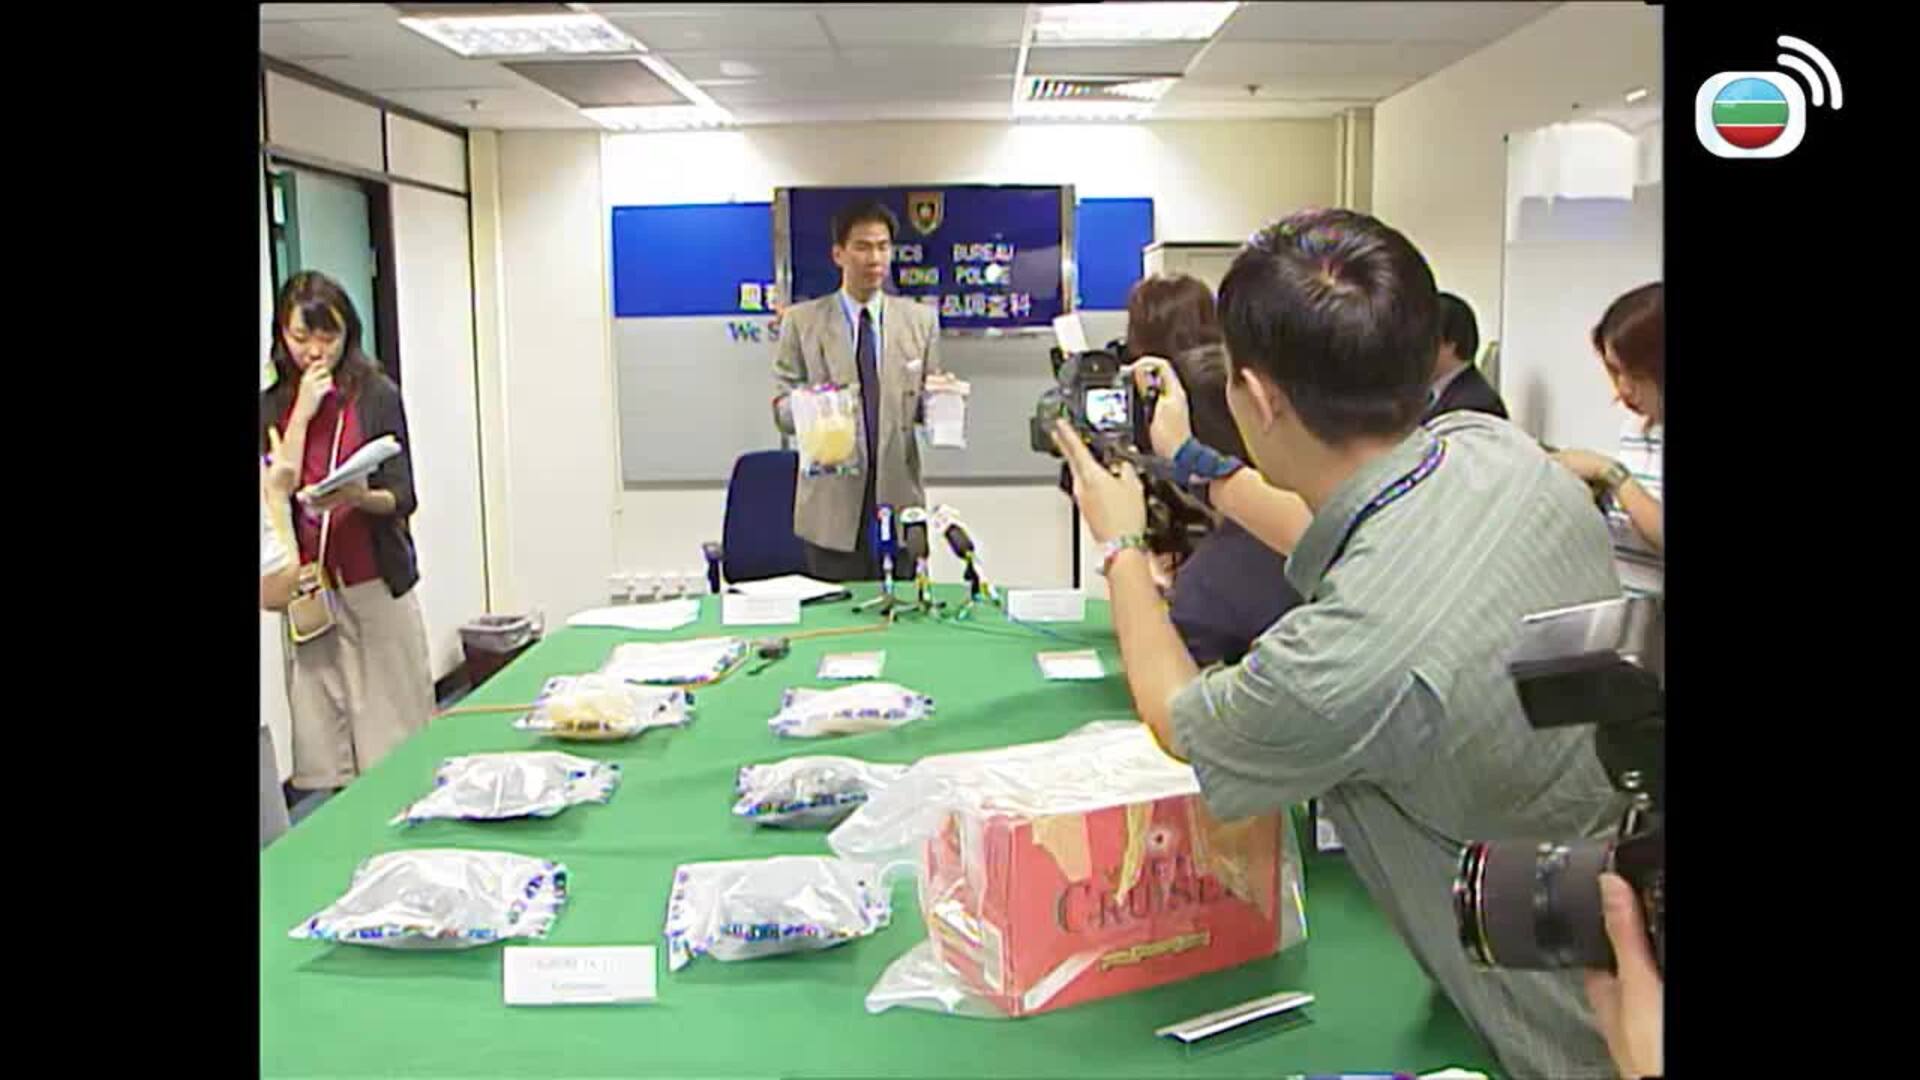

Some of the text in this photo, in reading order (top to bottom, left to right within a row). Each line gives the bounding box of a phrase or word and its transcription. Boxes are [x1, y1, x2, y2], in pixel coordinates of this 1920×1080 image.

[953, 242, 1014, 262] BUREAU
[955, 264, 1011, 285] POLE
[918, 292, 1031, 318] 品調查科
